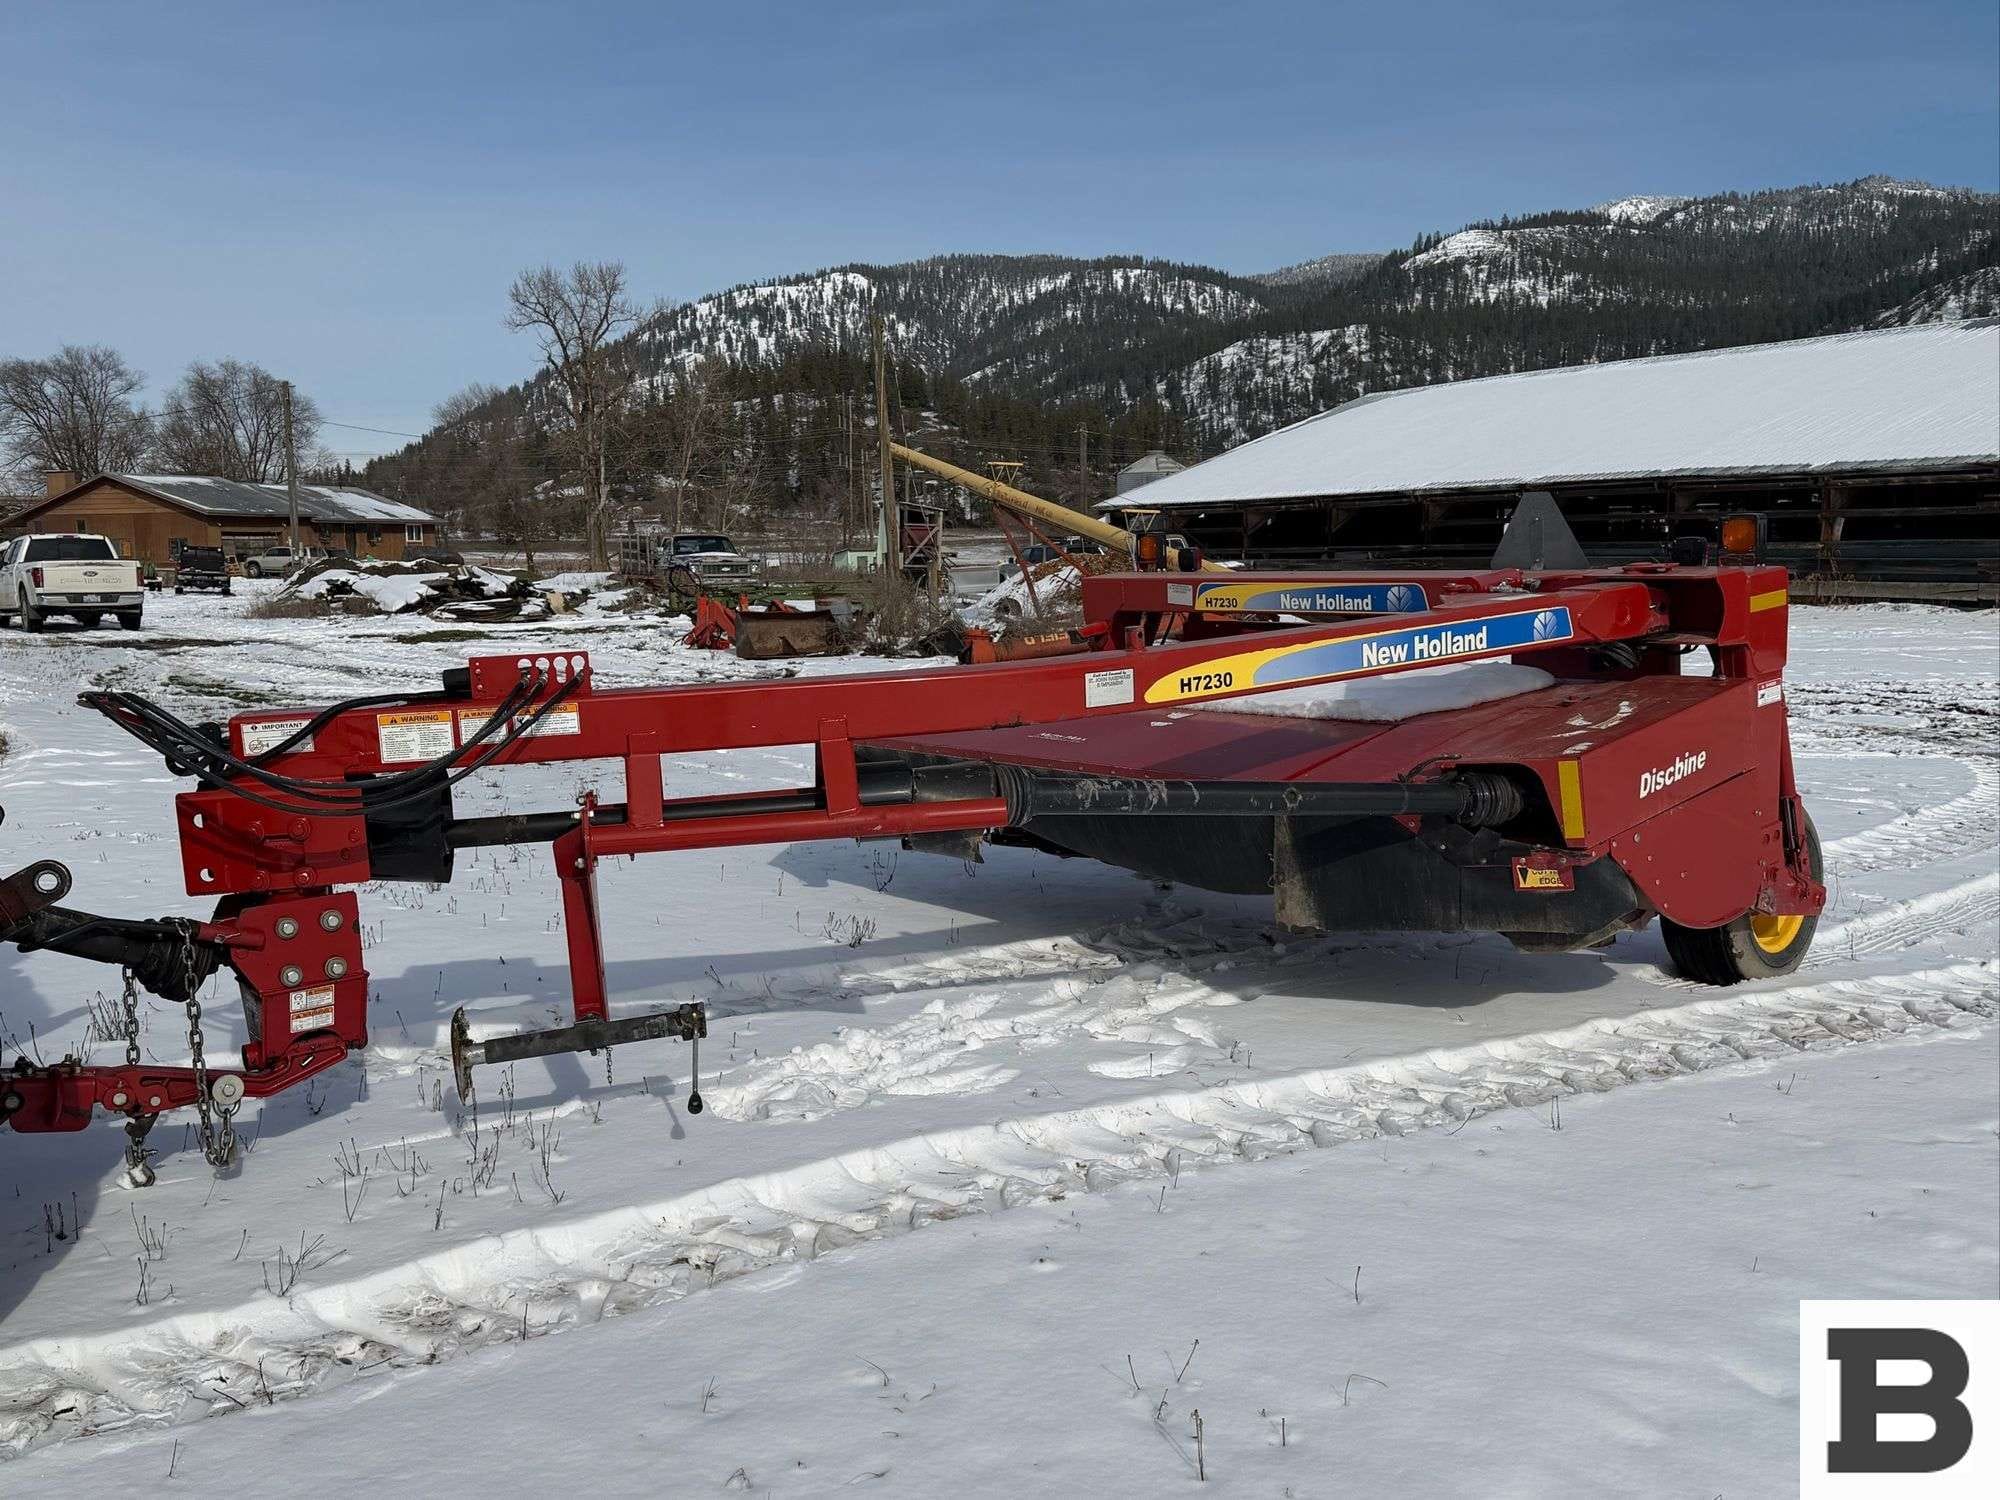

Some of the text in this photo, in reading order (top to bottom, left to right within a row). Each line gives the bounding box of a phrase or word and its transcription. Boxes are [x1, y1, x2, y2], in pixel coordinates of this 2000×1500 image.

[1205, 597, 1238, 608] H7230
[1280, 593, 1372, 611] New Holland
[1362, 625, 1487, 668] New Holland
[1180, 672, 1233, 693] H7230
[401, 714, 439, 723] WARNING
[1639, 750, 1707, 799] Discbine
